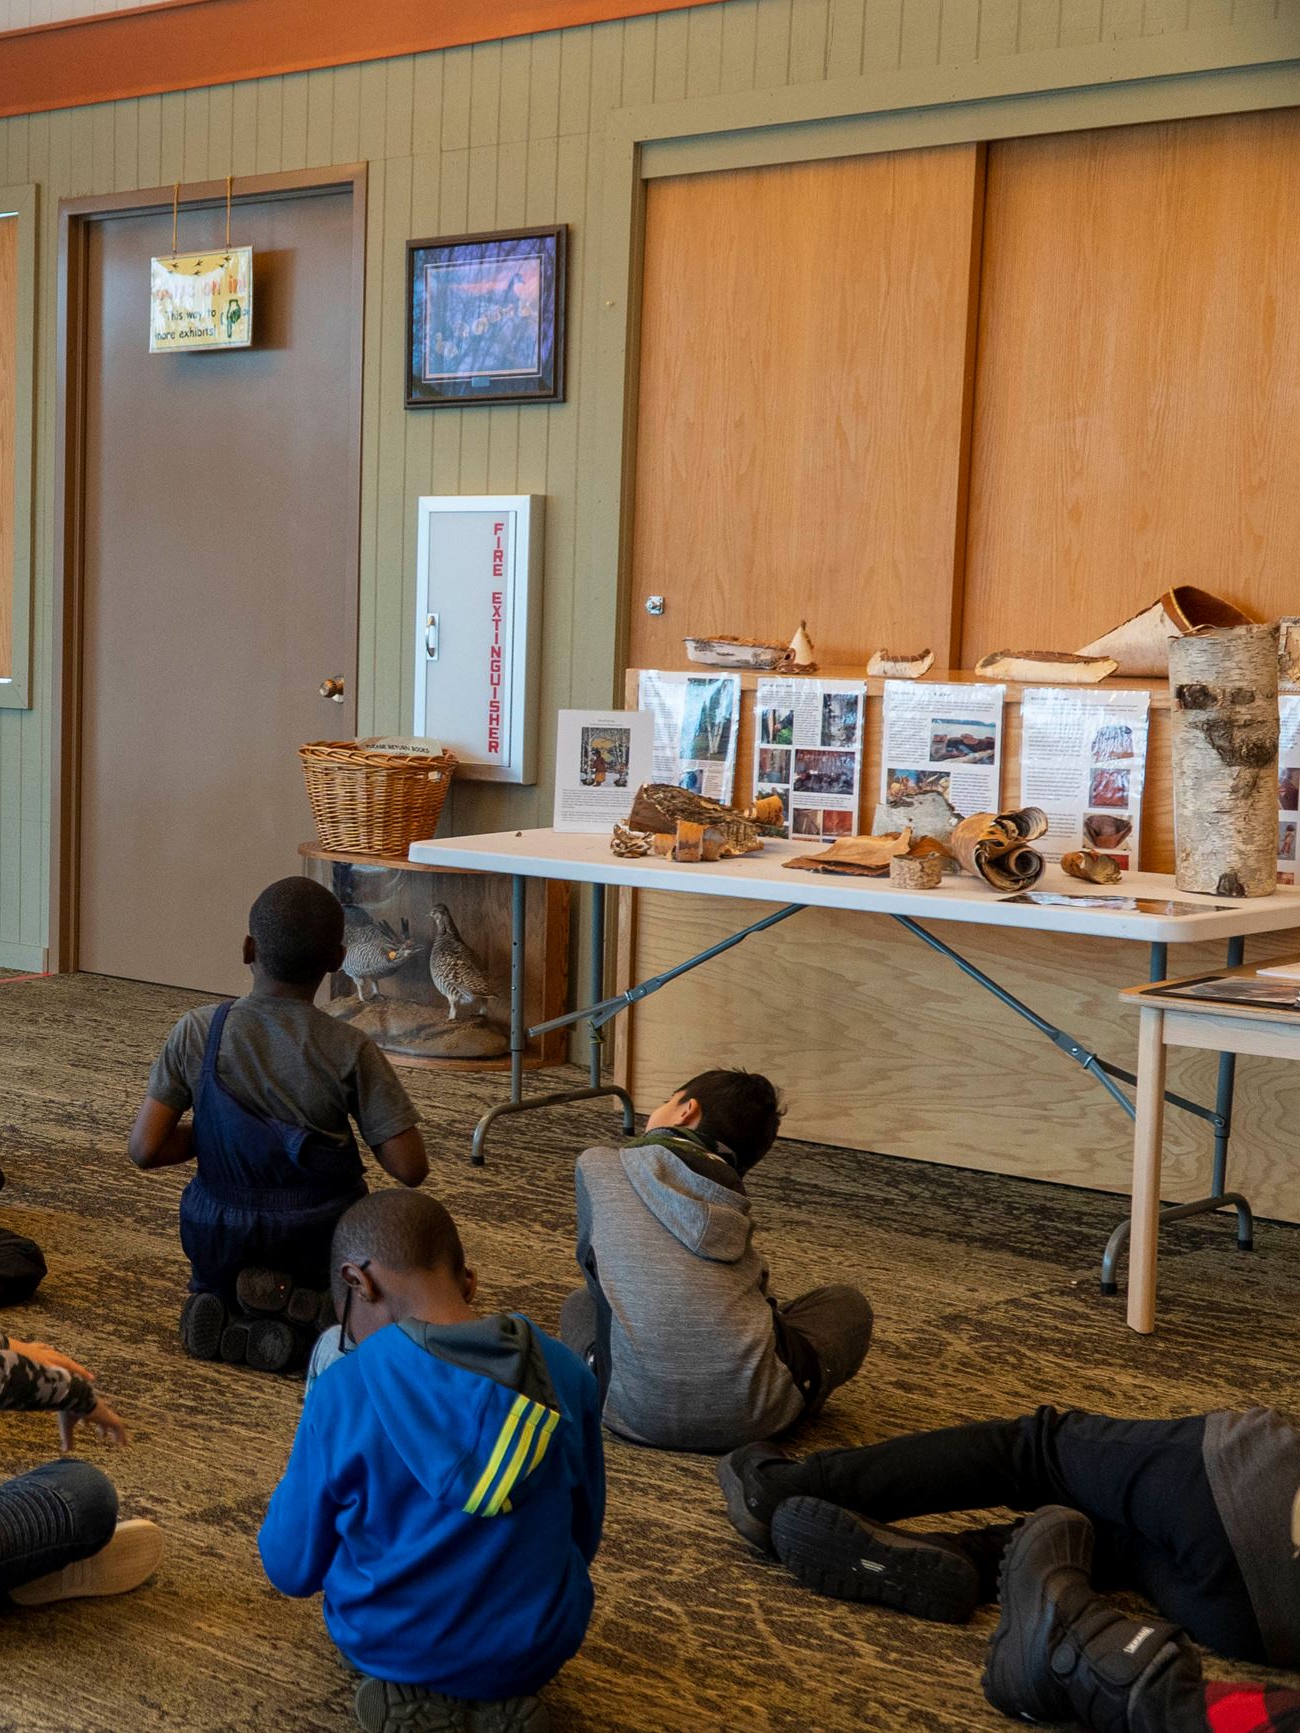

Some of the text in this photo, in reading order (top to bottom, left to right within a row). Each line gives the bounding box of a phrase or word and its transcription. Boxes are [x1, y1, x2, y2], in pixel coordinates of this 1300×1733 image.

[155, 331, 176, 341] more
[492, 523, 504, 577] FIRE
[488, 592, 503, 754] EXTINGUISHER
[387, 744, 411, 752] RETURN
[411, 746, 430, 754] BOOKS
